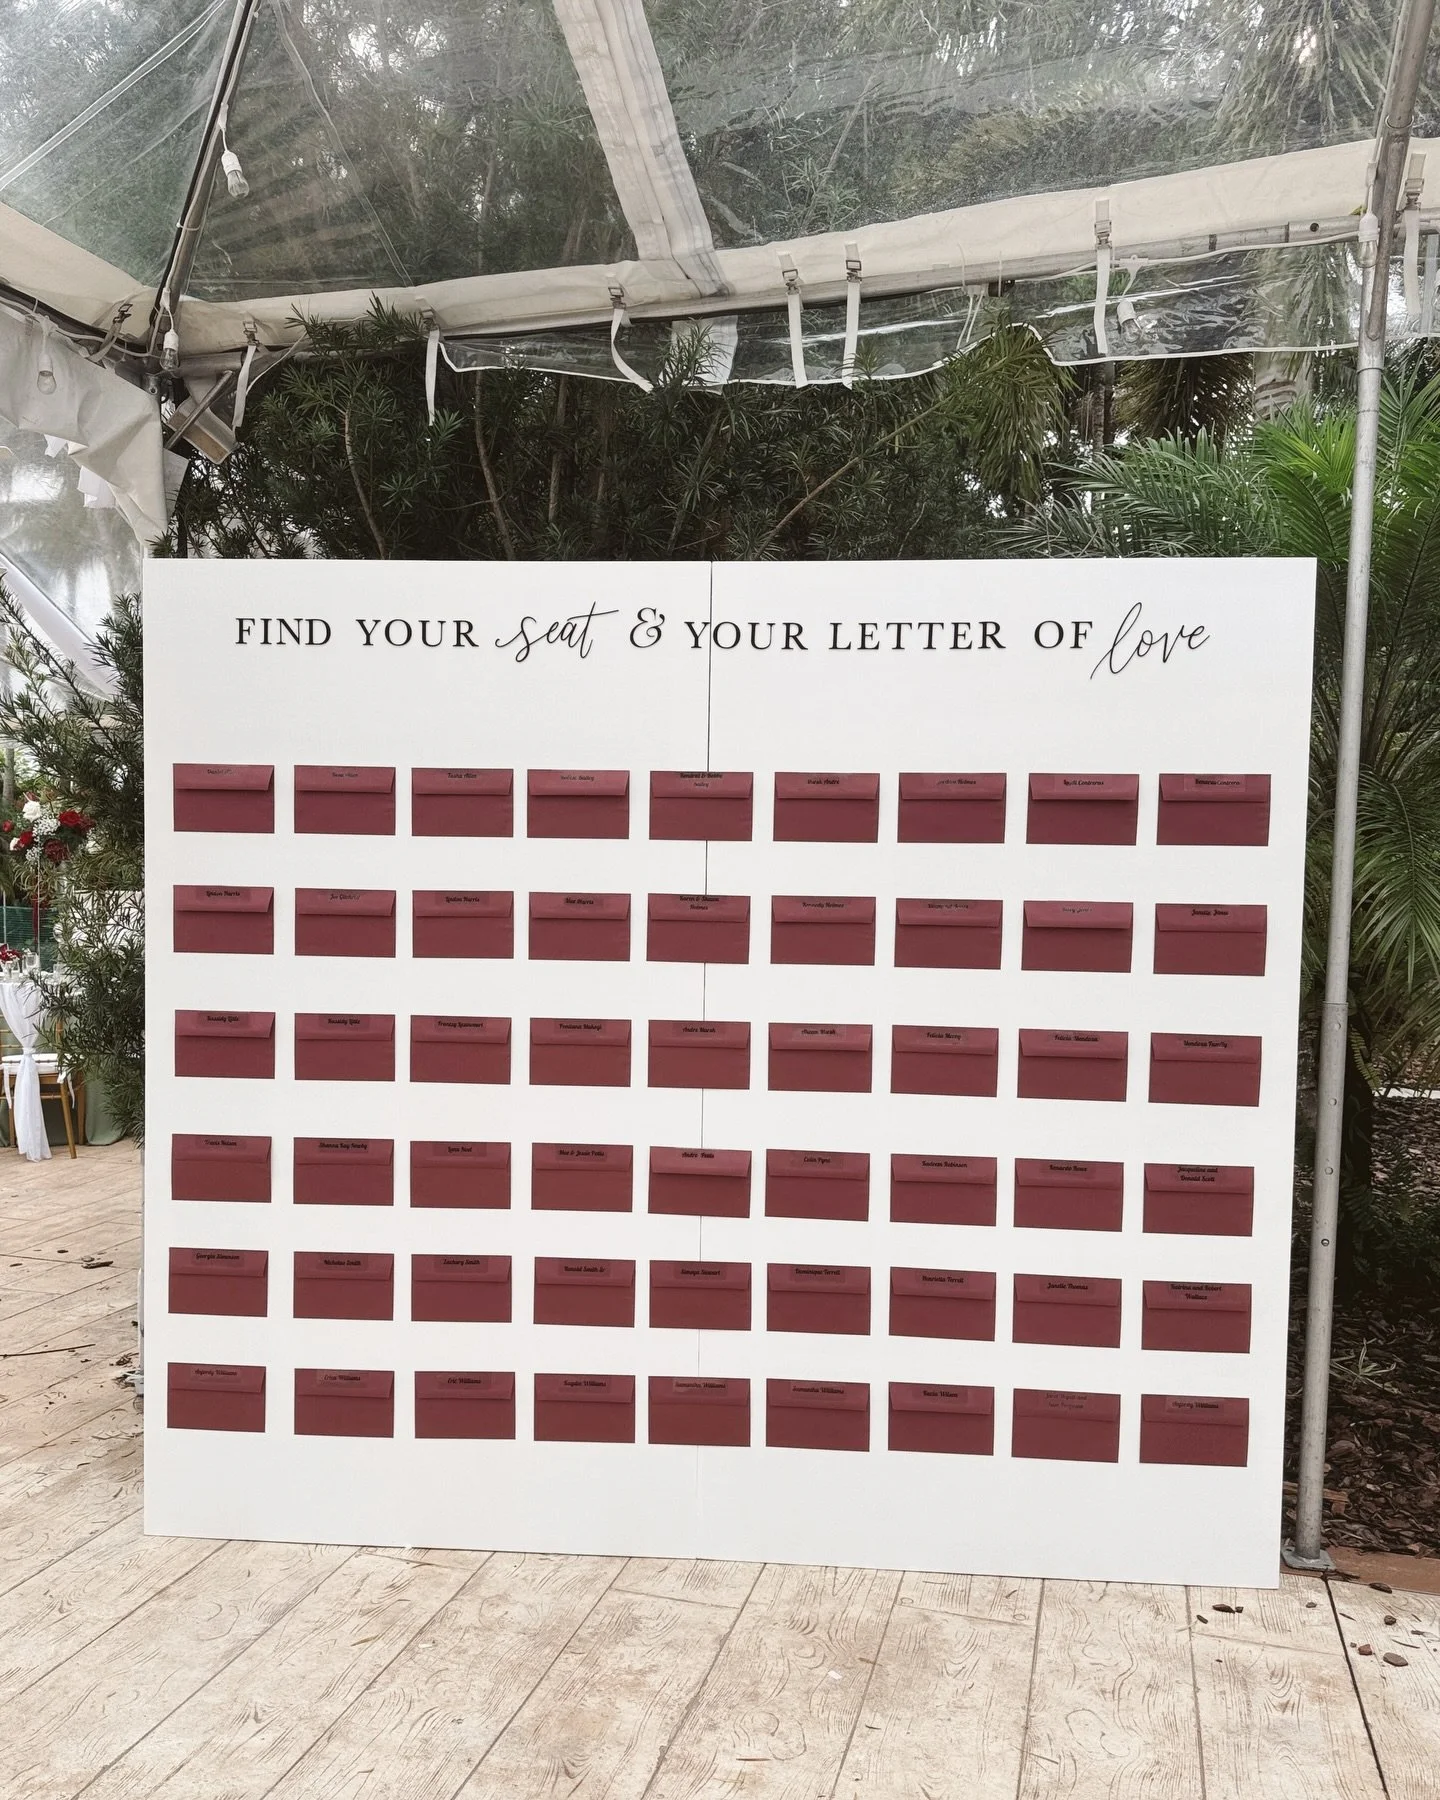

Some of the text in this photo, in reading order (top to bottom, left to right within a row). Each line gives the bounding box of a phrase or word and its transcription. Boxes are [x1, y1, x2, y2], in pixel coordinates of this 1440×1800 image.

[235, 601, 1211, 681] FIND YOUR seat & YOUR LETTER OF love
